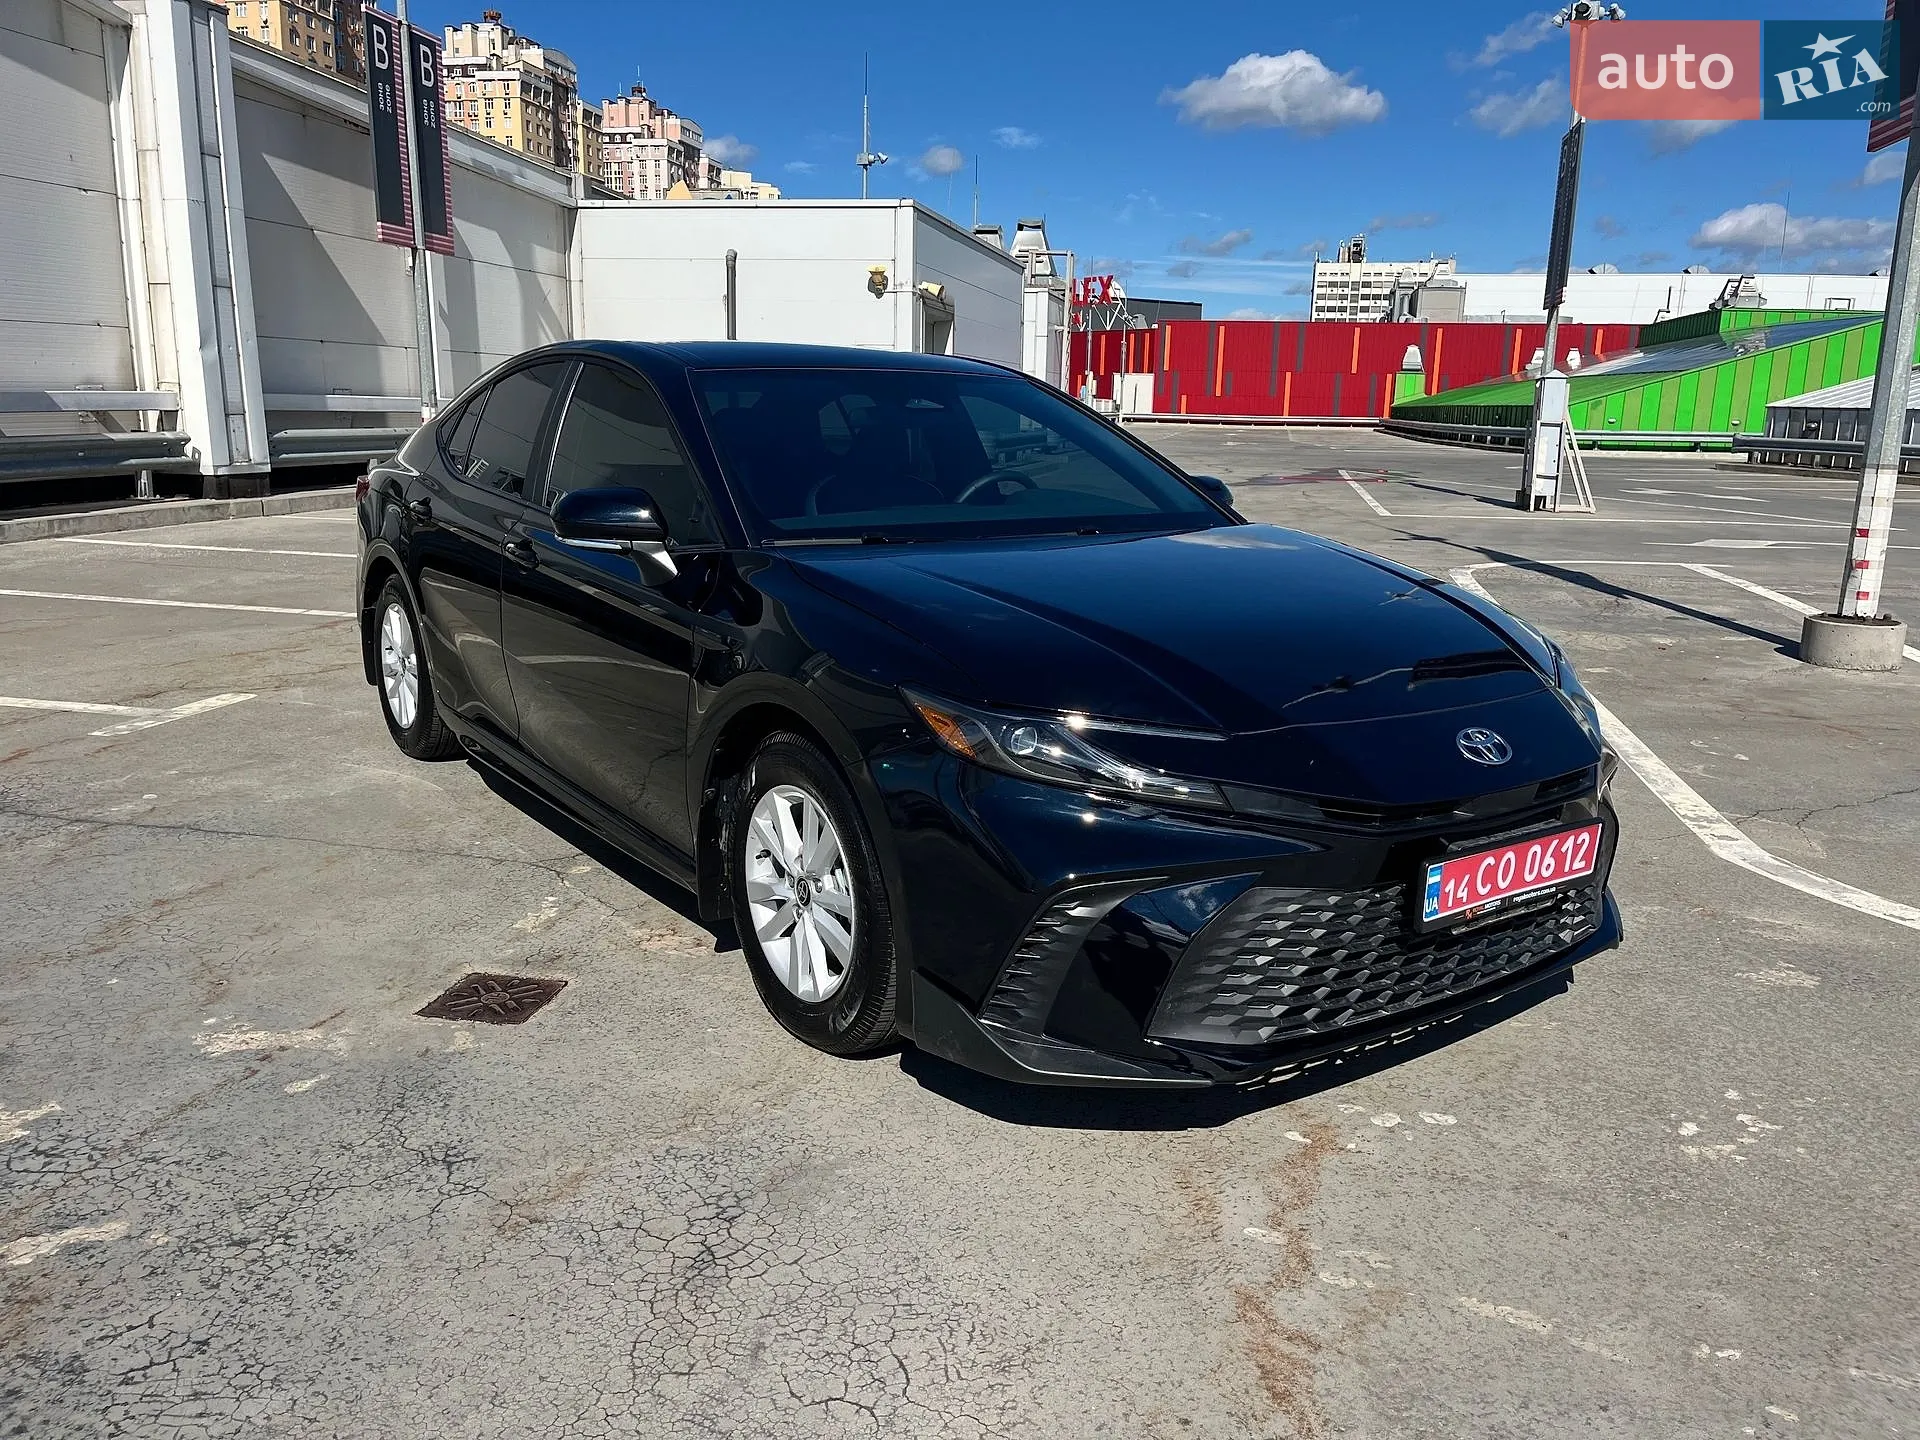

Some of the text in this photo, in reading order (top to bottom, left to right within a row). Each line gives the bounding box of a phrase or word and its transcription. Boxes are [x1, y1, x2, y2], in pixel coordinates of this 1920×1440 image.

[373, 24, 389, 70] B
[420, 44, 435, 88] B
[377, 82, 385, 111] зона
[1444, 831, 1591, 907] 14 CO 0612
[1425, 898, 1439, 913] UA
